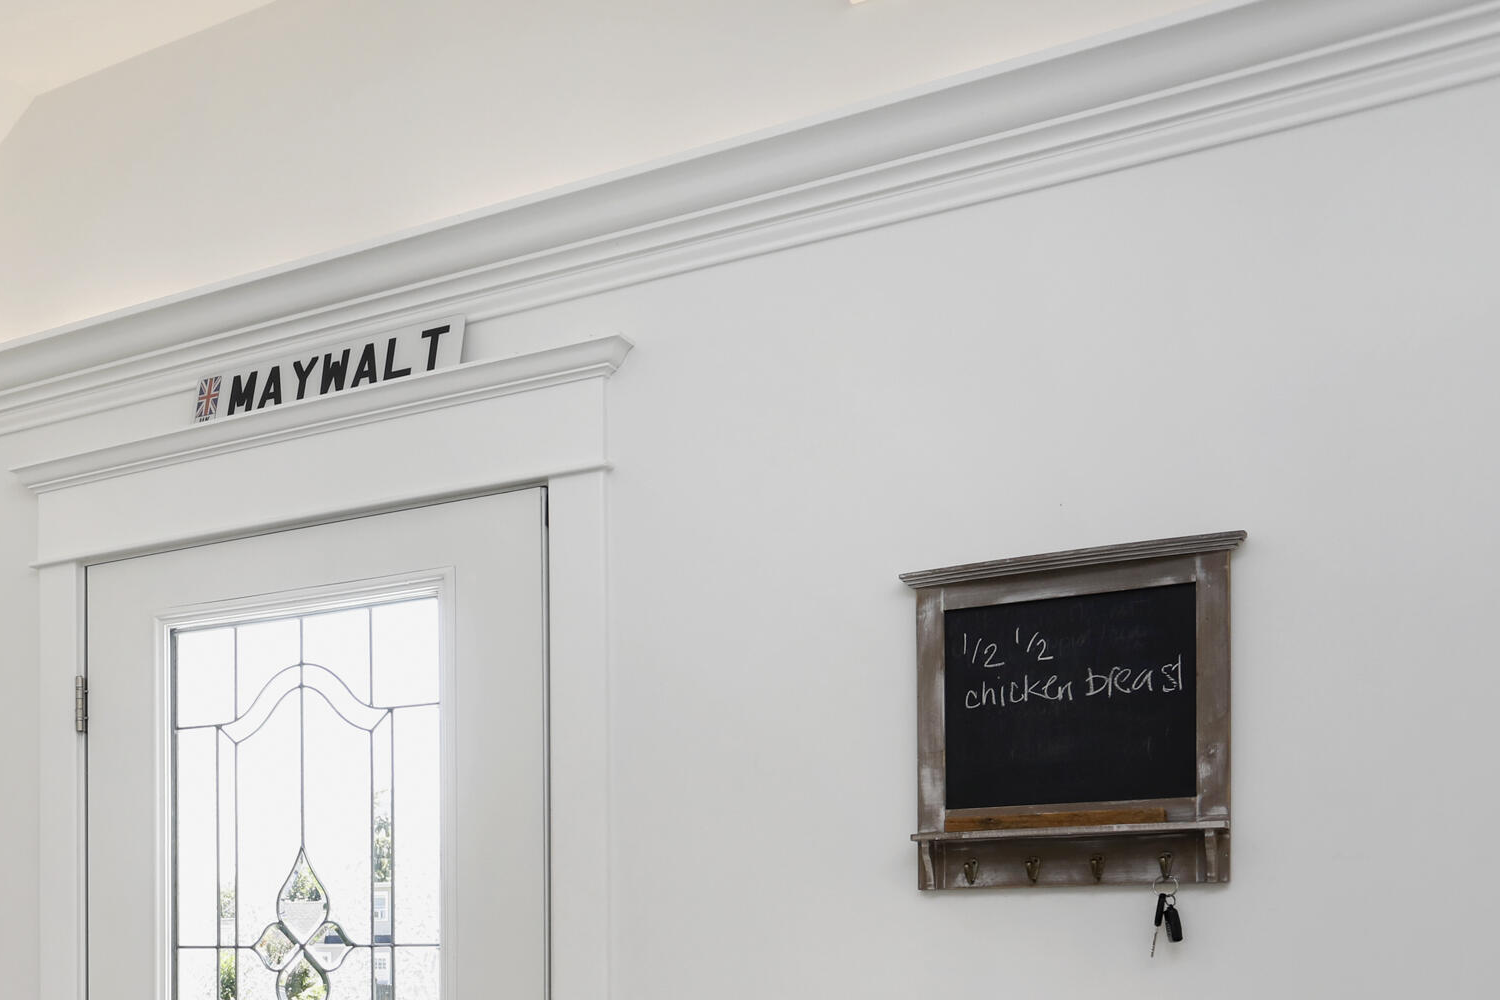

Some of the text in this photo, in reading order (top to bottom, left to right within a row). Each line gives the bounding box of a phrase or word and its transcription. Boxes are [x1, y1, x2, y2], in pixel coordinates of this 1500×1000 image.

[227, 324, 451, 416] MAYWALT
[962, 632, 1005, 668] 1/2
[1015, 627, 1054, 661] 1/2
[965, 654, 1183, 709] chicken breast
